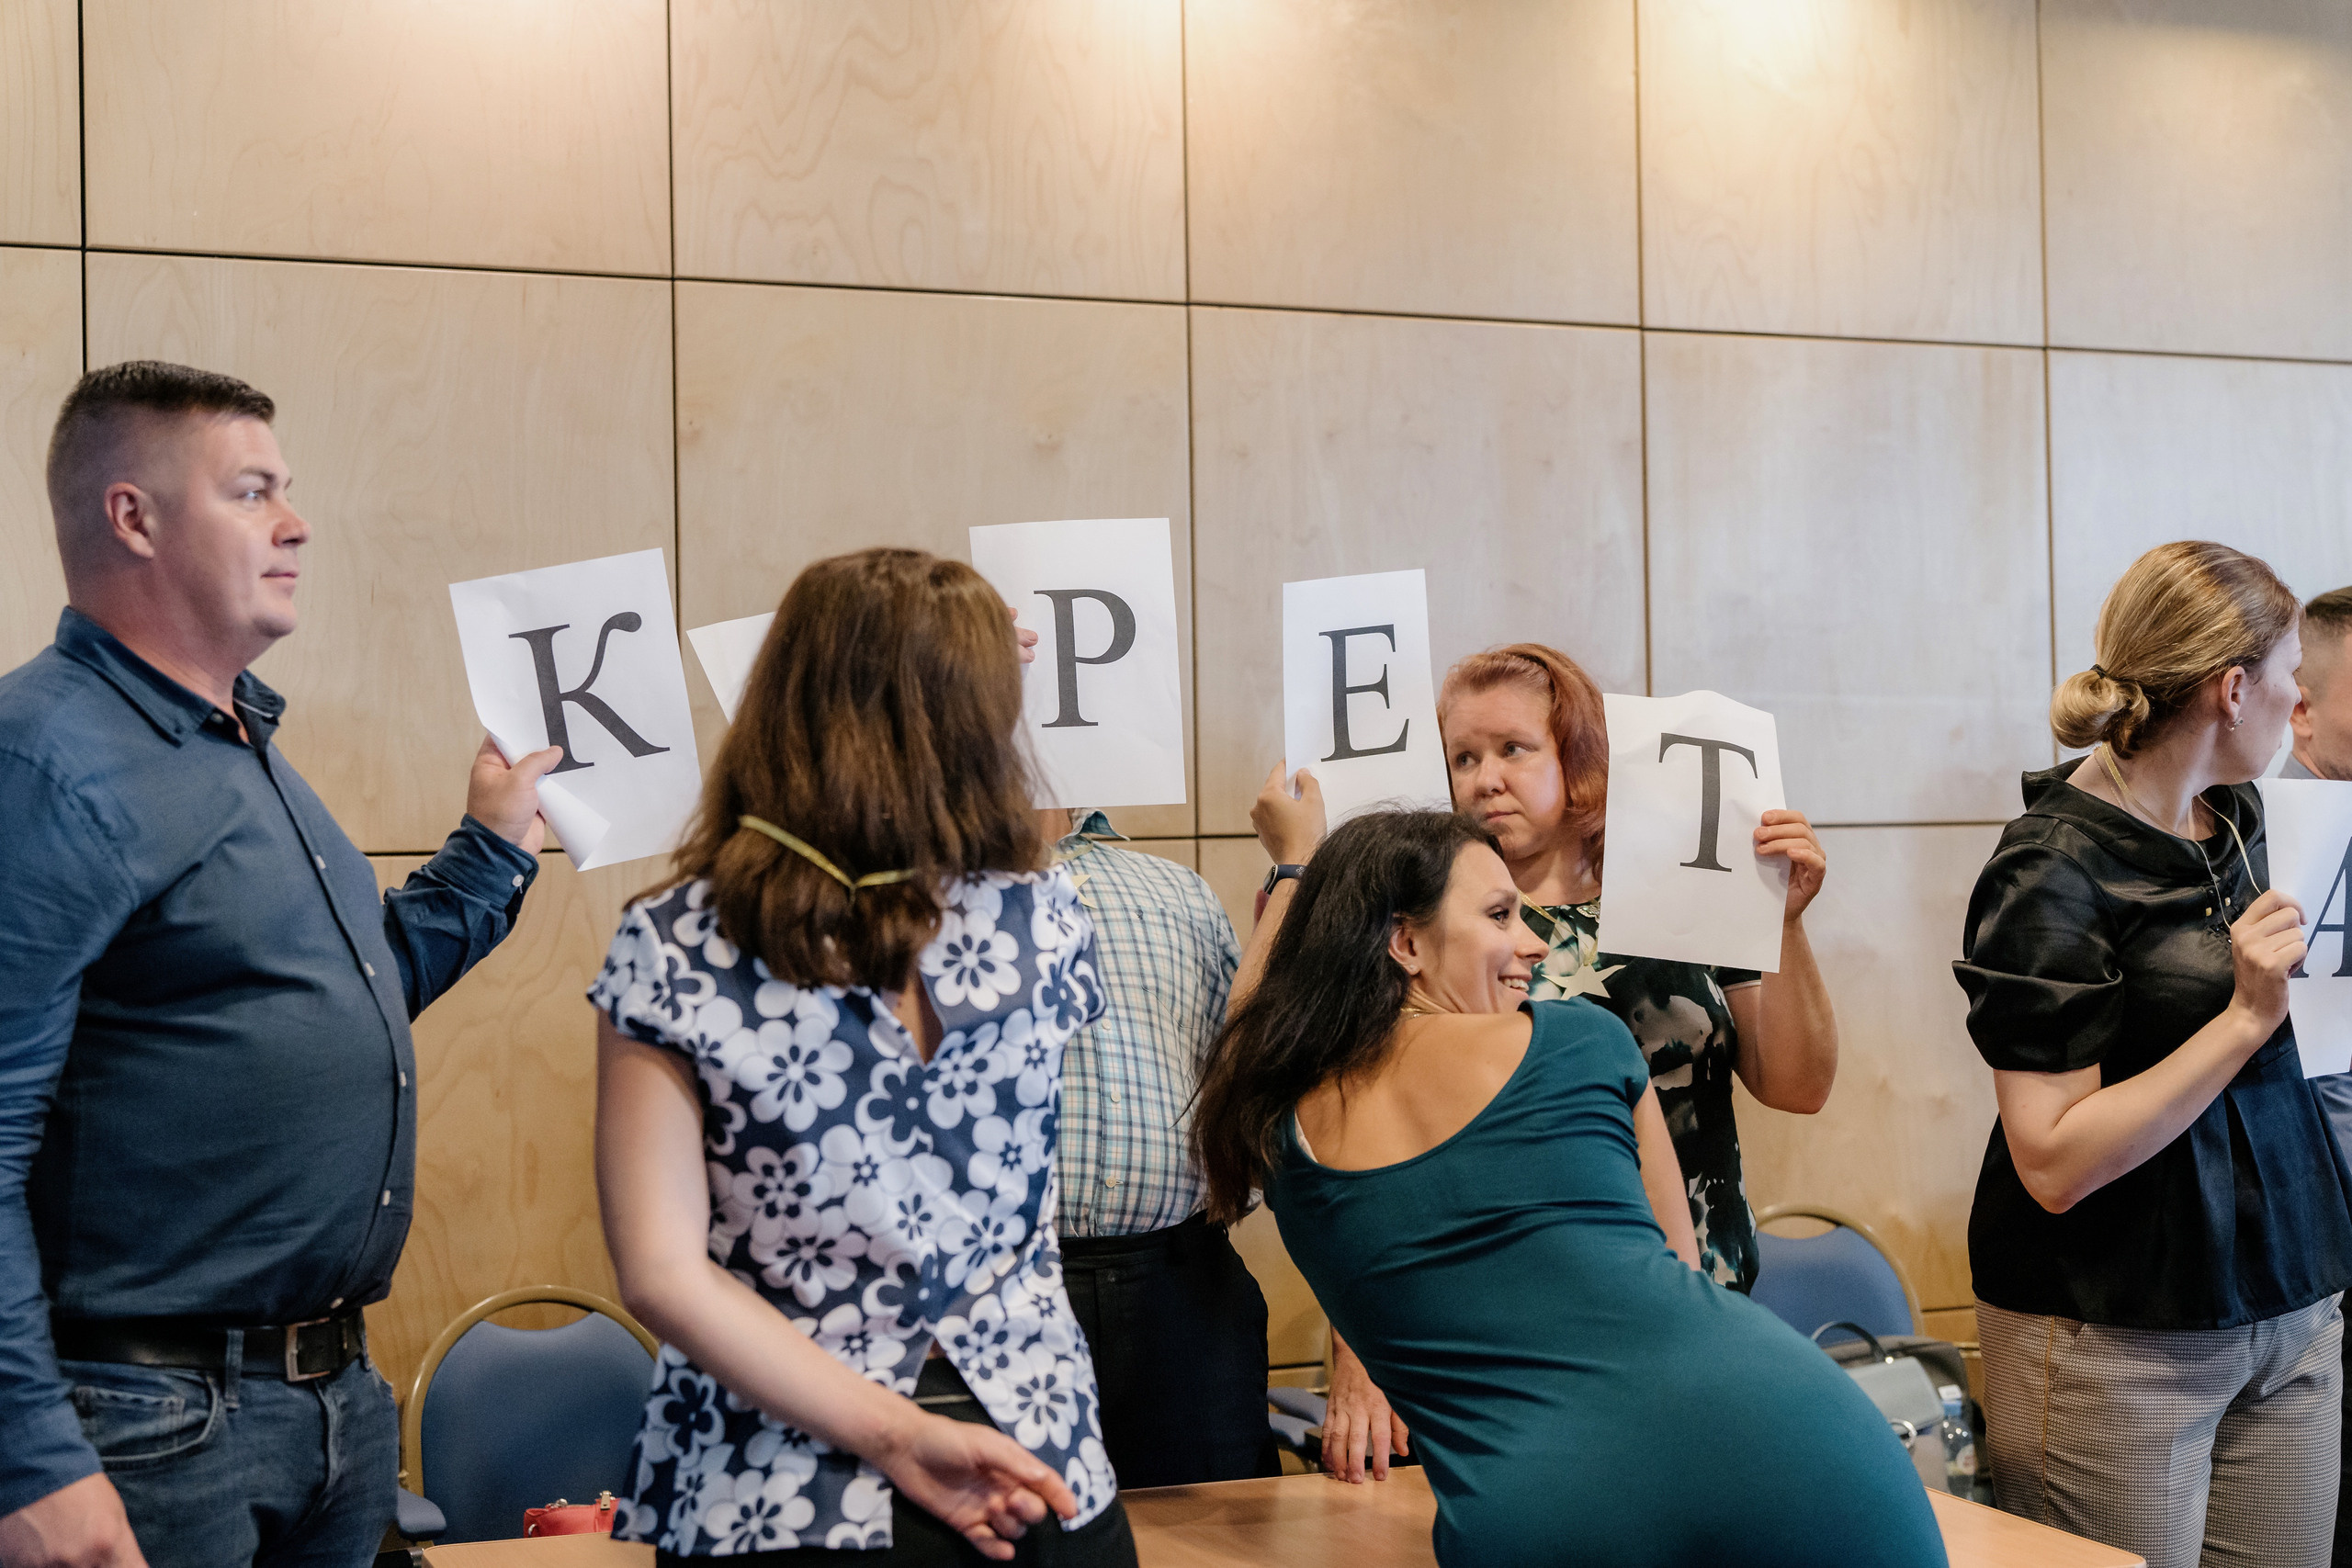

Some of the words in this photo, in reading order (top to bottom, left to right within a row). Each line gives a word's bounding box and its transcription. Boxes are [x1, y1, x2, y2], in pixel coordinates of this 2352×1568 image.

[508, 611, 671, 776] К
[1318, 624, 1409, 762] Е
[1658, 732, 1758, 873] Т
